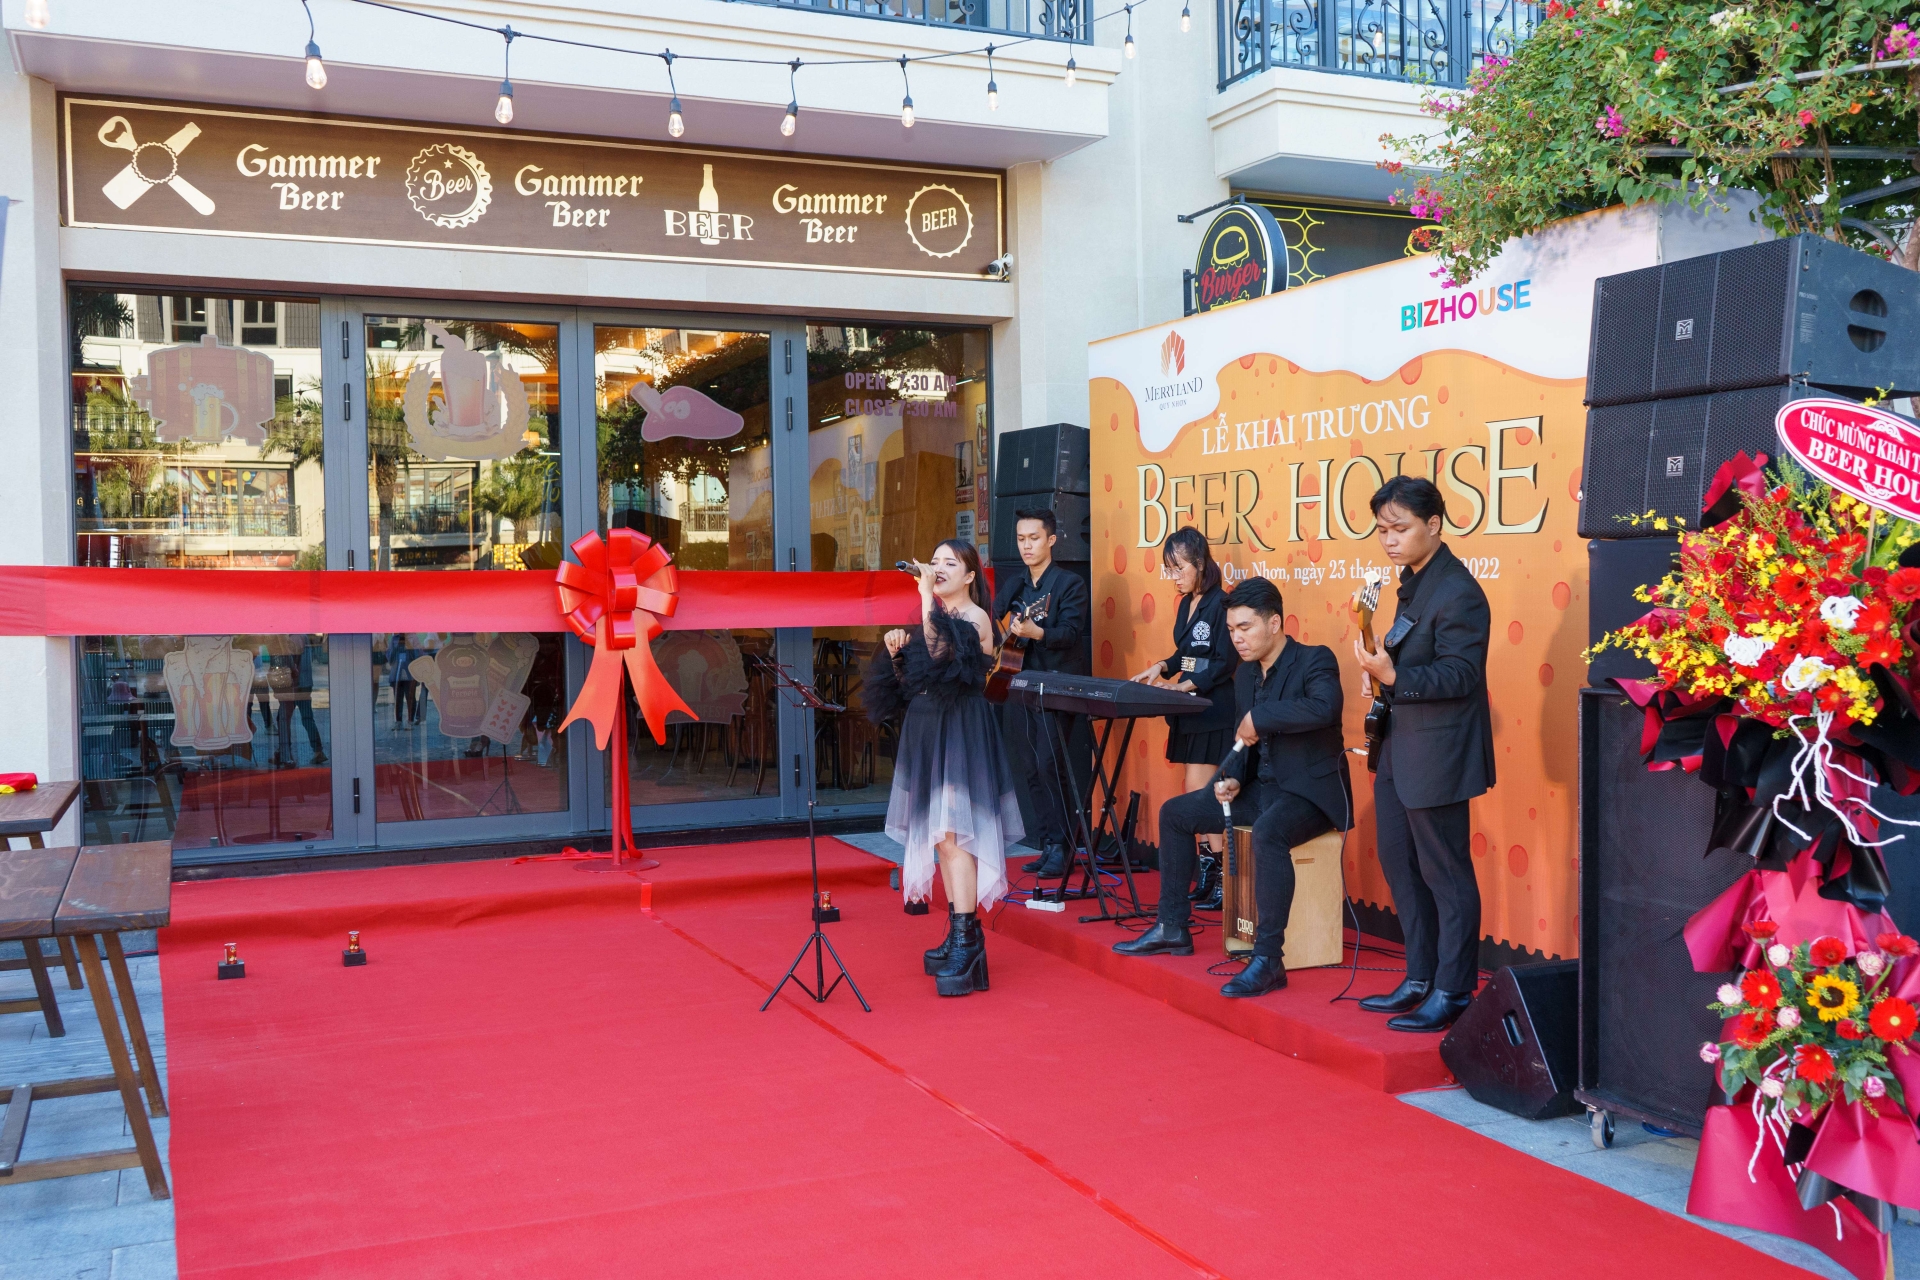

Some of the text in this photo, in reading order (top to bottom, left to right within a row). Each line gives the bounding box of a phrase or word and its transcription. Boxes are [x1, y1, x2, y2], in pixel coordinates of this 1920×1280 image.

[236, 143, 382, 179] Gammer
[271, 182, 344, 211] Beer
[419, 169, 474, 201] Beer
[514, 164, 644, 198] Gammer
[545, 200, 610, 228] Beer
[773, 183, 887, 216] Gammer
[663, 210, 754, 241] BEER
[799, 217, 858, 244] Beer
[921, 207, 957, 233] BEER
[1201, 258, 1261, 304] Burger
[1401, 279, 1531, 332] BIZHOUSE
[845, 371, 957, 392] OPEN 7:30 AM
[1144, 376, 1203, 403] MERRYLAND
[845, 399, 957, 418] CLOSE 7:30 AM
[1201, 394, 1432, 455] LỄ KHAI TRƯƠNG
[1800, 409, 1835, 438] CHÚC
[1836, 421, 1877, 455] MỪNG
[1876, 438, 1911, 469] KHAI
[1806, 436, 1869, 481] BEER
[1136, 463, 1276, 552] BEER
[1223, 562, 1249, 585] Quy
[1252, 561, 1290, 582] Nhơn,
[1293, 561, 1326, 586] ngày
[1329, 559, 1346, 579] 23
